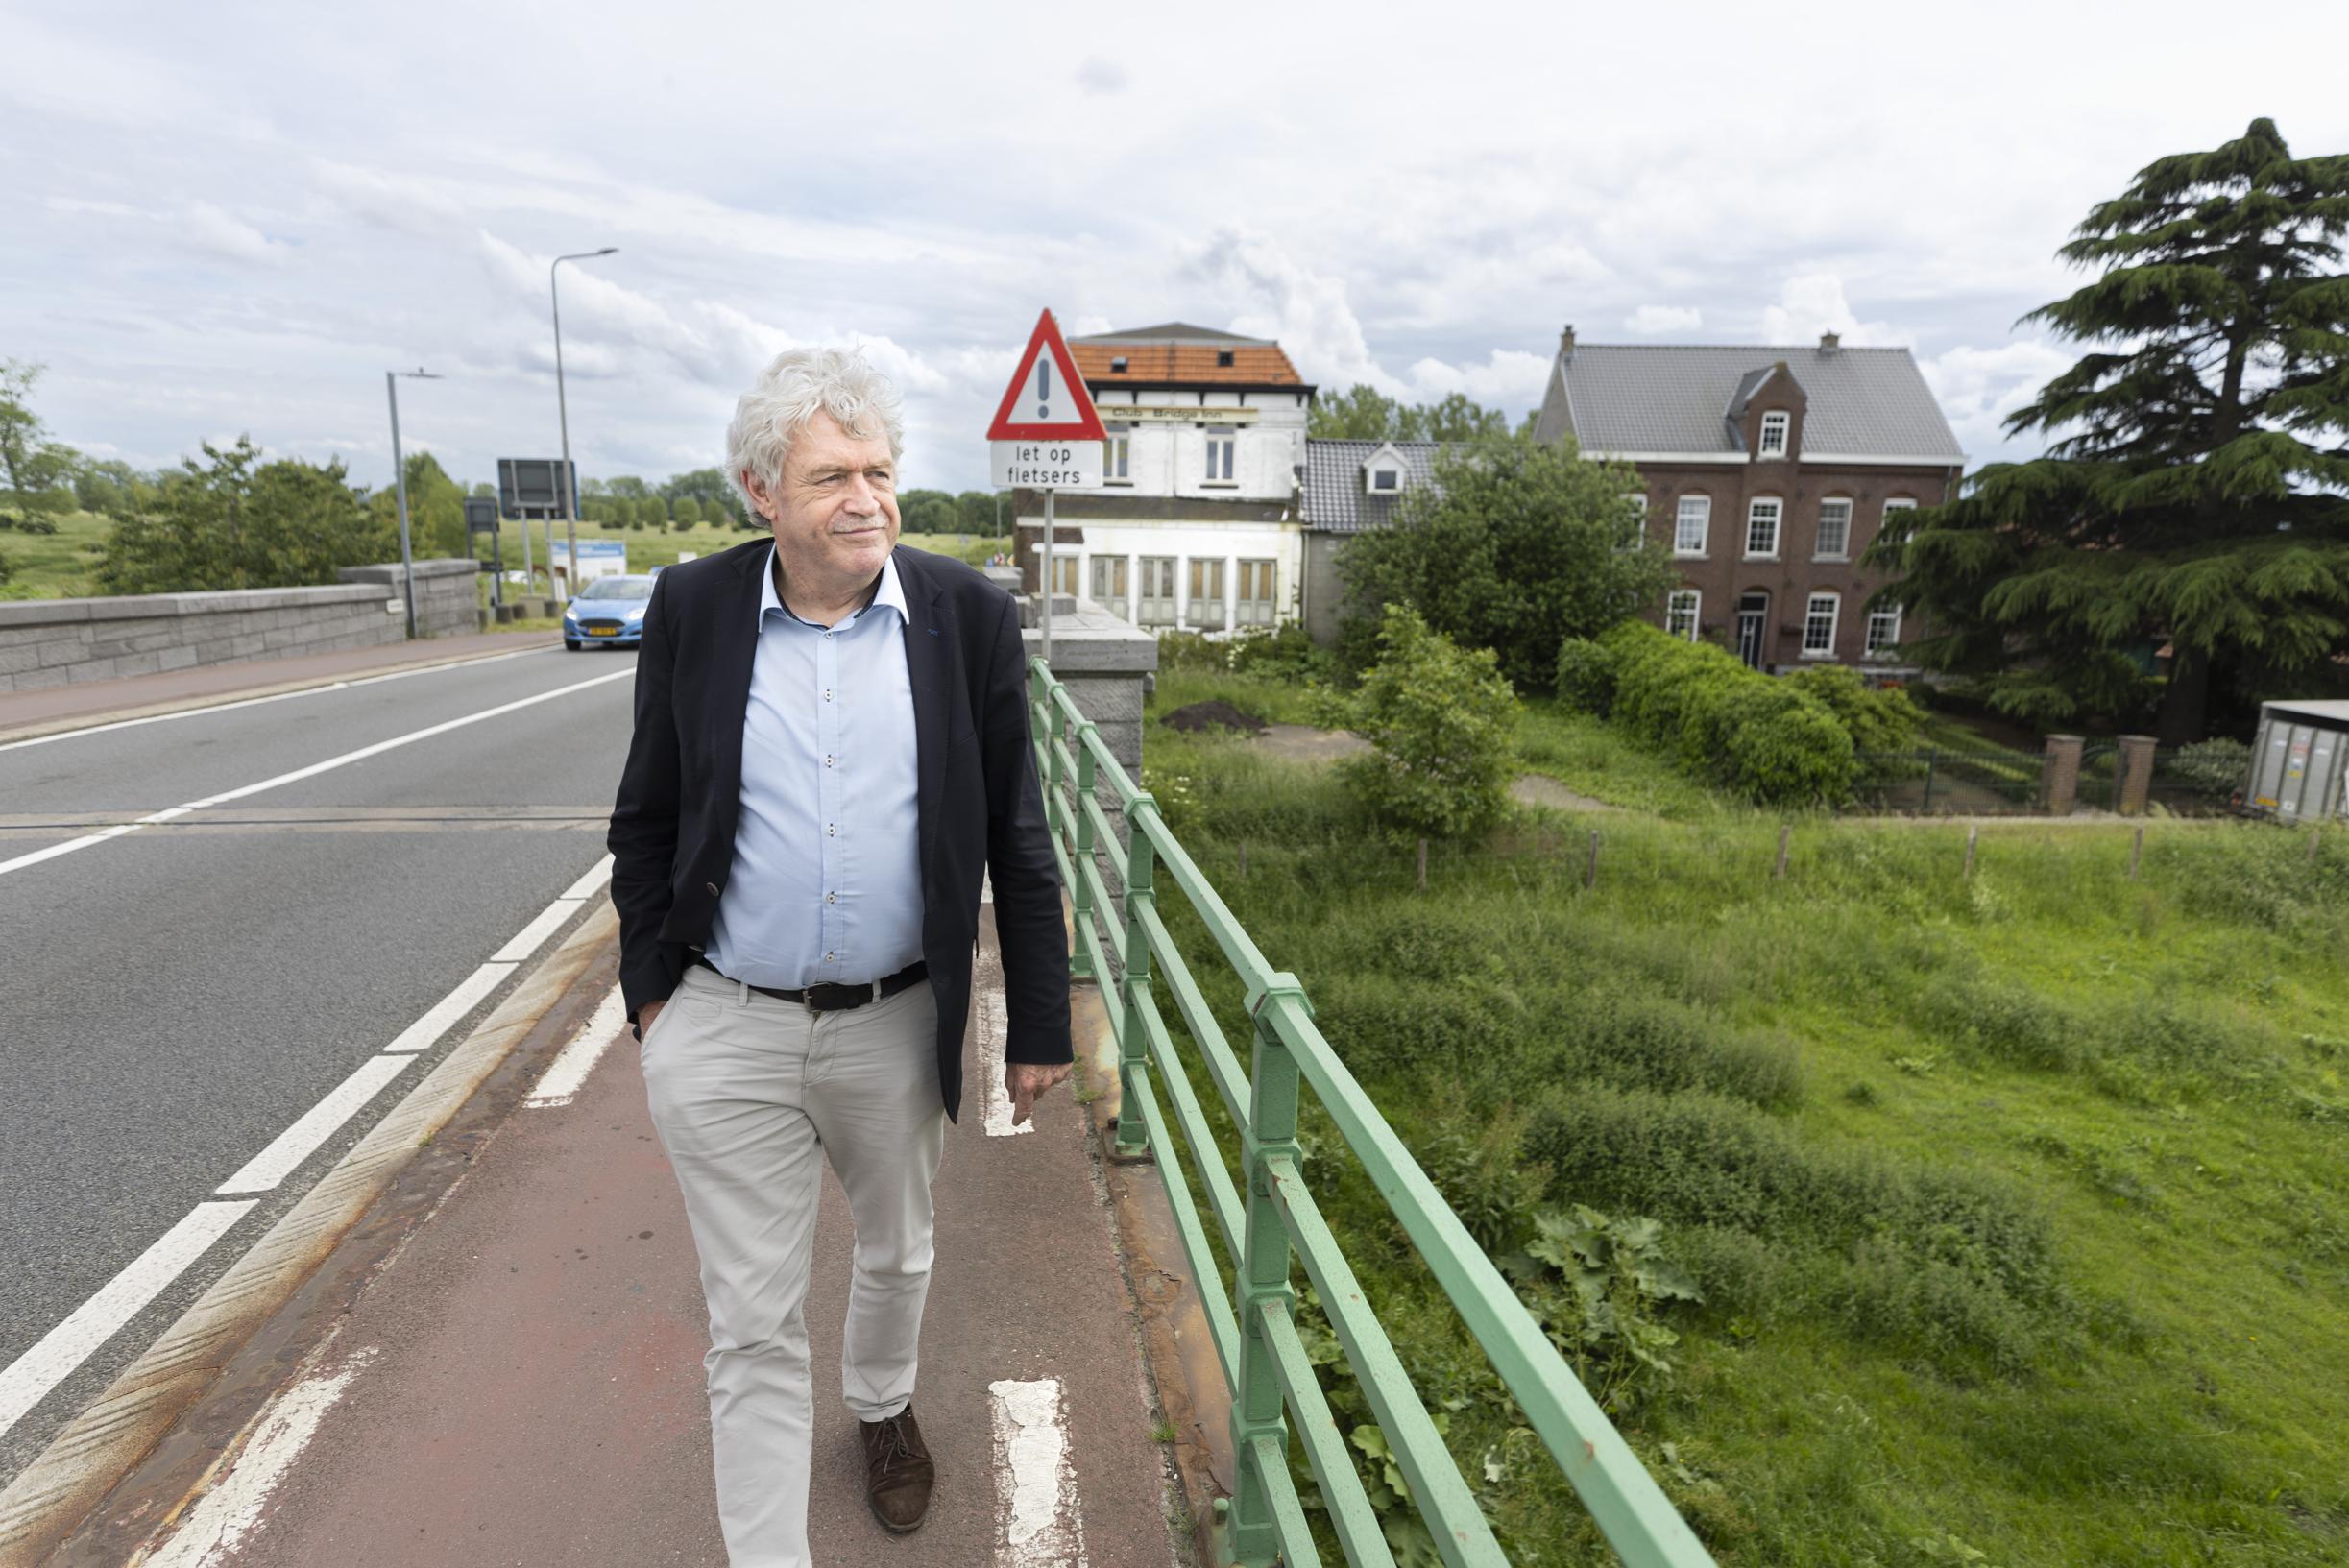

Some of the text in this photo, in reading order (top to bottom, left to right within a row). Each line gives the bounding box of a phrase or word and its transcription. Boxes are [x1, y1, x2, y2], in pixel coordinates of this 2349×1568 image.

[1112, 407, 1143, 417] Club
[1016, 446, 1070, 465] let op
[1008, 467, 1080, 483] fietsers
